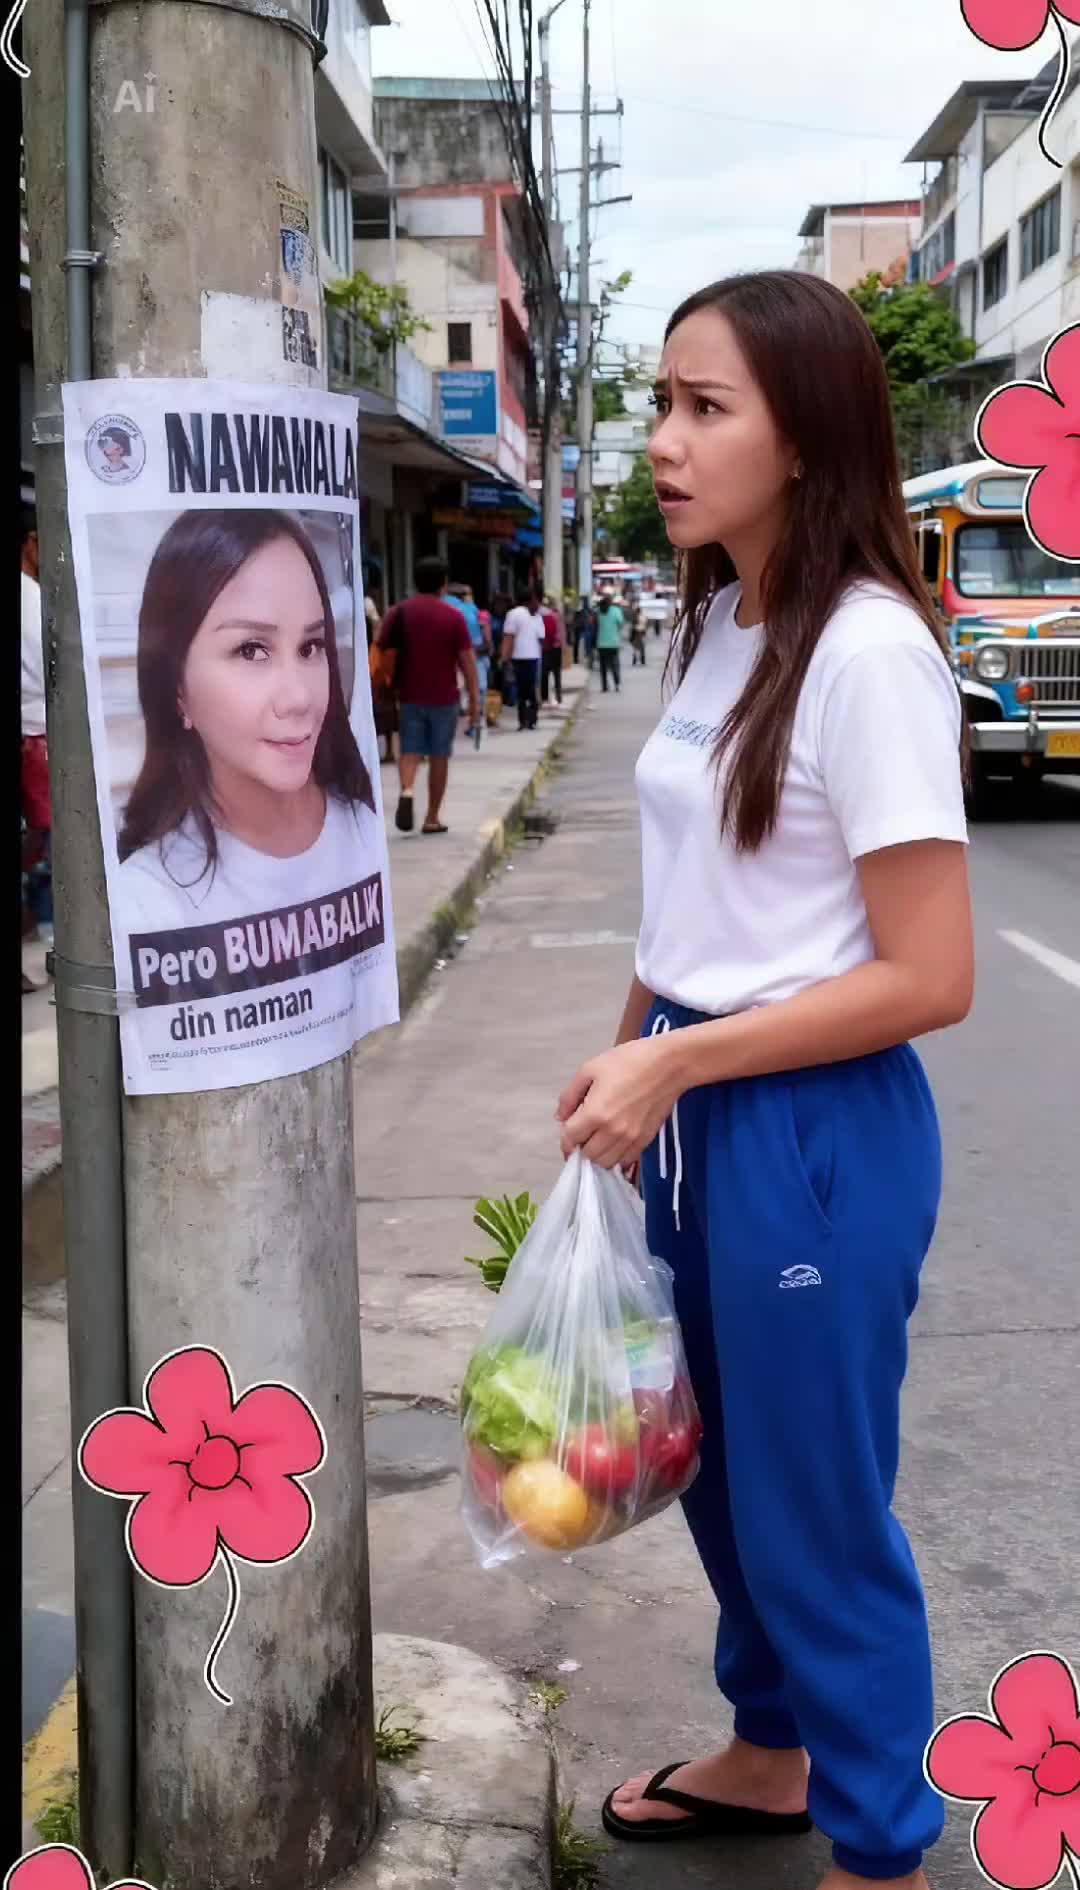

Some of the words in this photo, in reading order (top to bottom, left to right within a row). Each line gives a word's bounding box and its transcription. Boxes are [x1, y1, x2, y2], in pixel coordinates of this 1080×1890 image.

[165, 412, 358, 500] NAWAWALA
[137, 946, 218, 989] Pero
[169, 1004, 216, 1041] din
[224, 987, 313, 1033] naman
